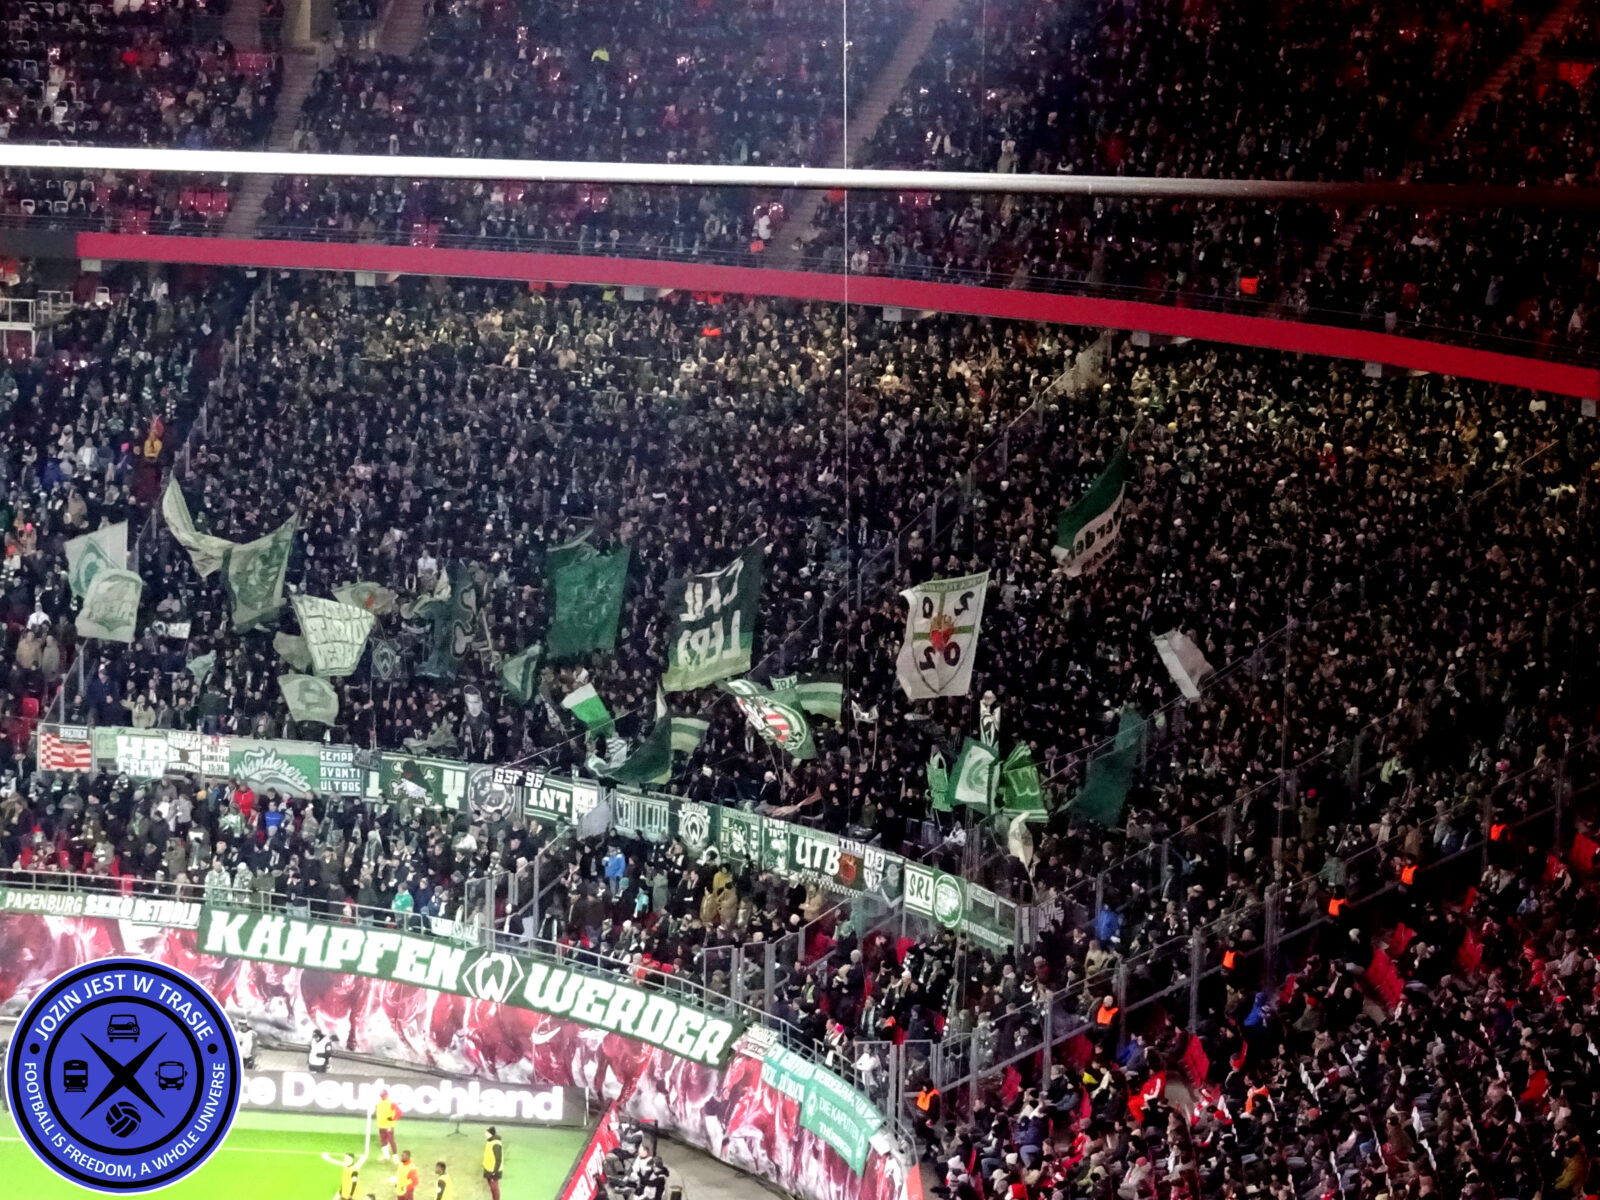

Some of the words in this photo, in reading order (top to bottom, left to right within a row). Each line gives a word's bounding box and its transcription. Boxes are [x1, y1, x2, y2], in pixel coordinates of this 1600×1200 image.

[233, 746, 311, 793] Wanderers
[320, 767, 360, 778] AVANTI
[494, 768, 523, 785] GSF
[795, 836, 842, 876] UTB
[909, 873, 930, 901] SRL
[5, 892, 83, 913] PAPENBURG
[204, 910, 467, 990] KÄMPFEN
[524, 963, 733, 1064] WERDER
